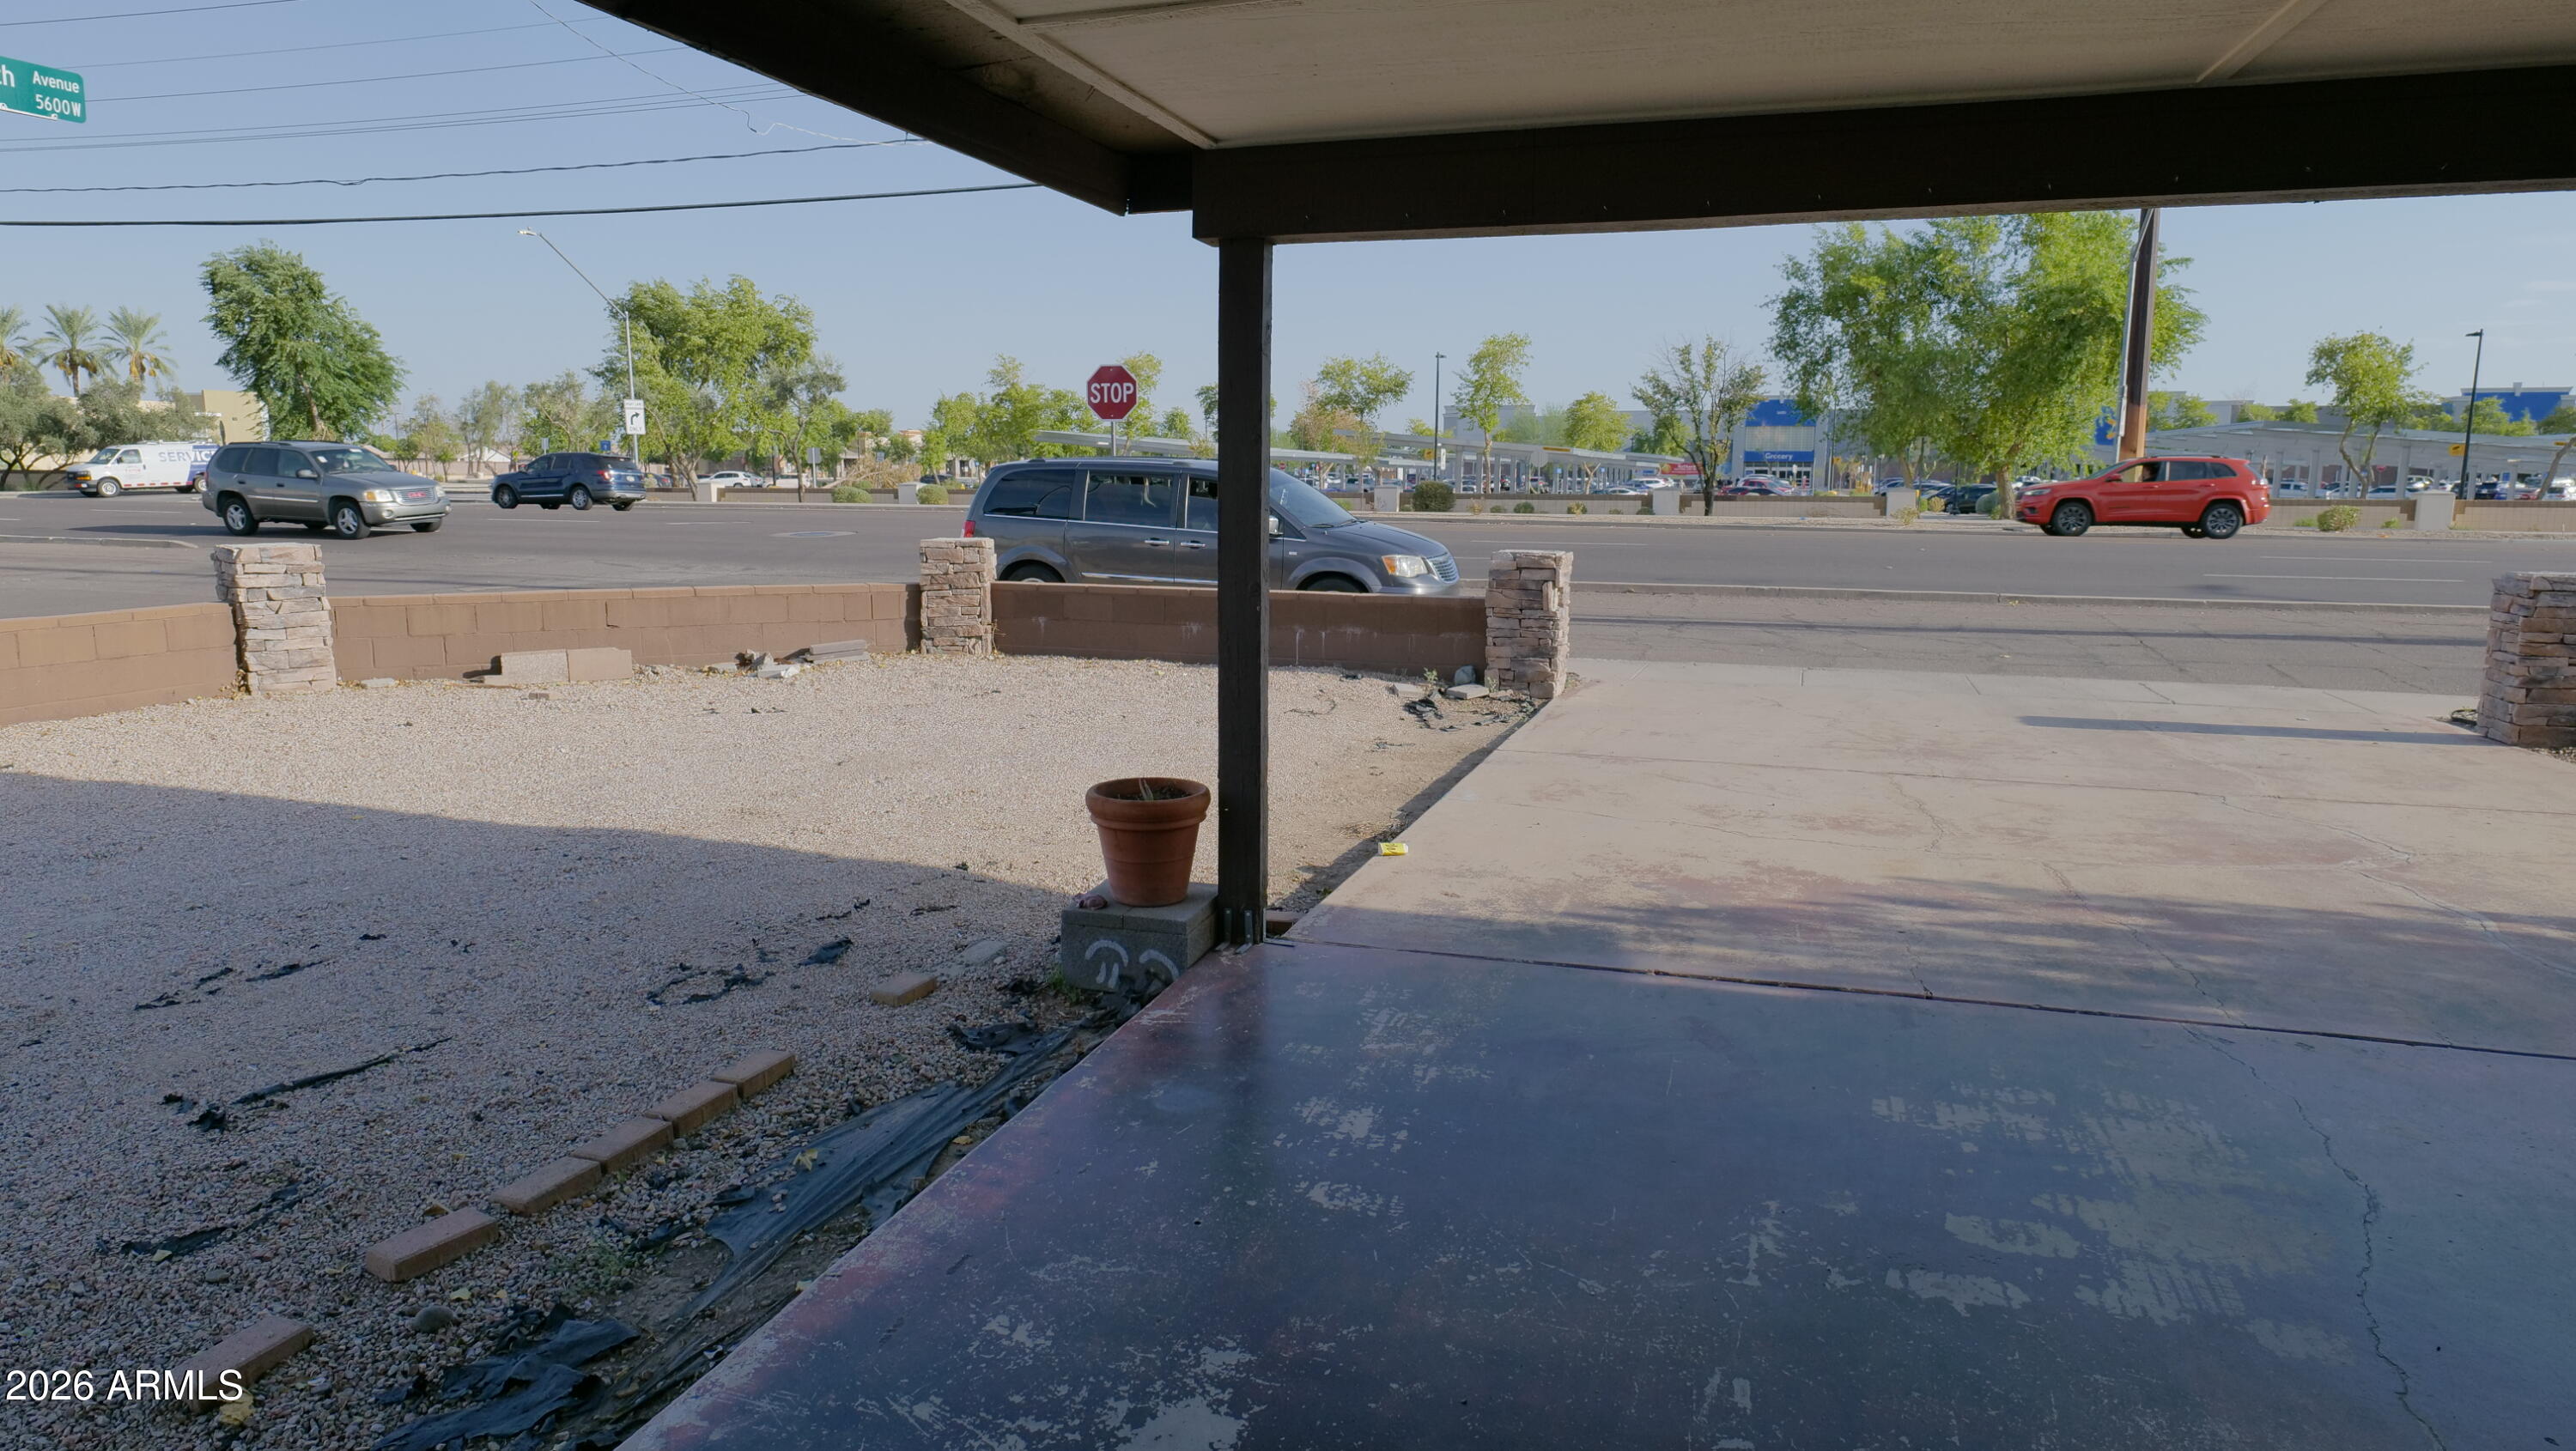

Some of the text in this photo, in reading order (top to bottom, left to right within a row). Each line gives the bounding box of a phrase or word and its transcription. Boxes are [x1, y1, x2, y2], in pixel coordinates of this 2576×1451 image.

[33, 70, 80, 94] Avenue
[35, 94, 81, 117] 5600W
[1091, 382, 1134, 403] STOP
[1765, 452, 1793, 461] Grocery
